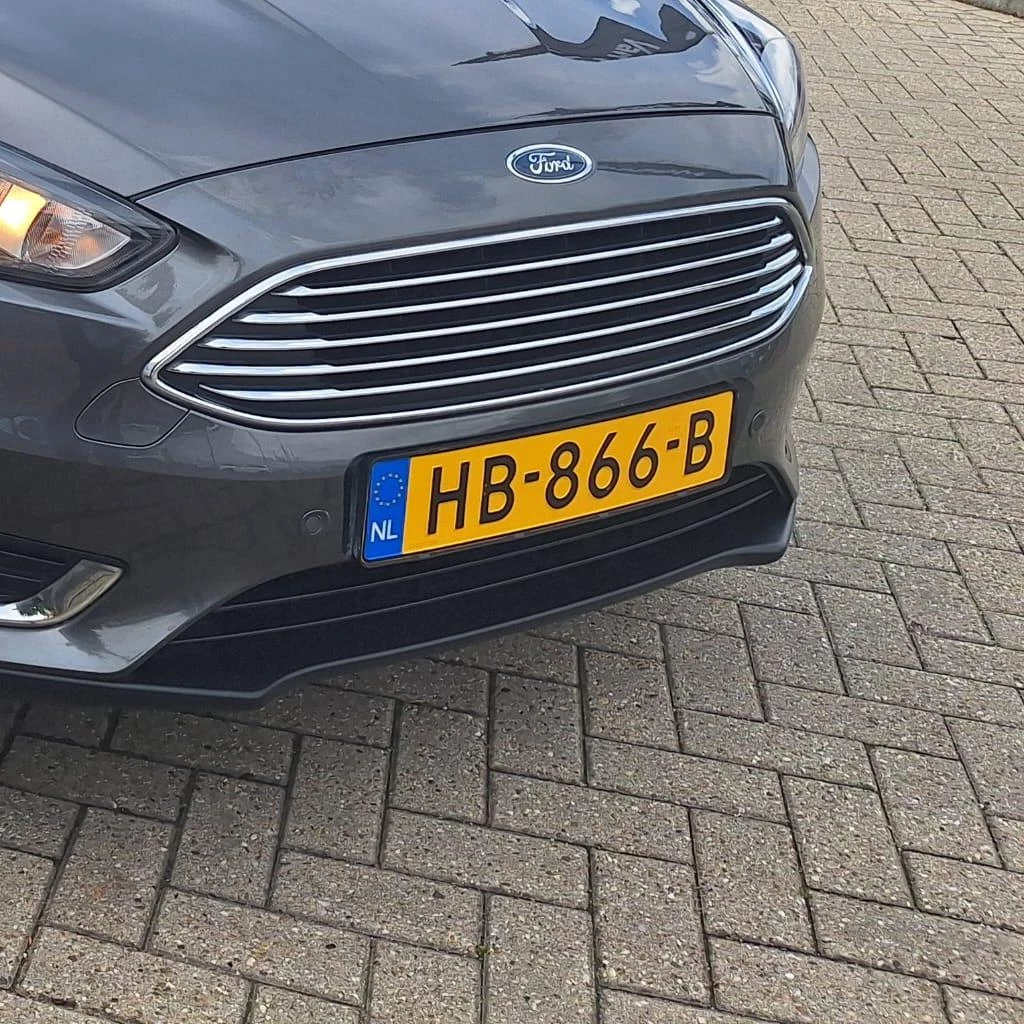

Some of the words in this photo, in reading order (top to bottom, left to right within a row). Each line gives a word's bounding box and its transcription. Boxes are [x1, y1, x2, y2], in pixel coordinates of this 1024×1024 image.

[528, 151, 574, 175] Ford
[370, 520, 398, 542] NL
[427, 410, 715, 535] HB-866-B
